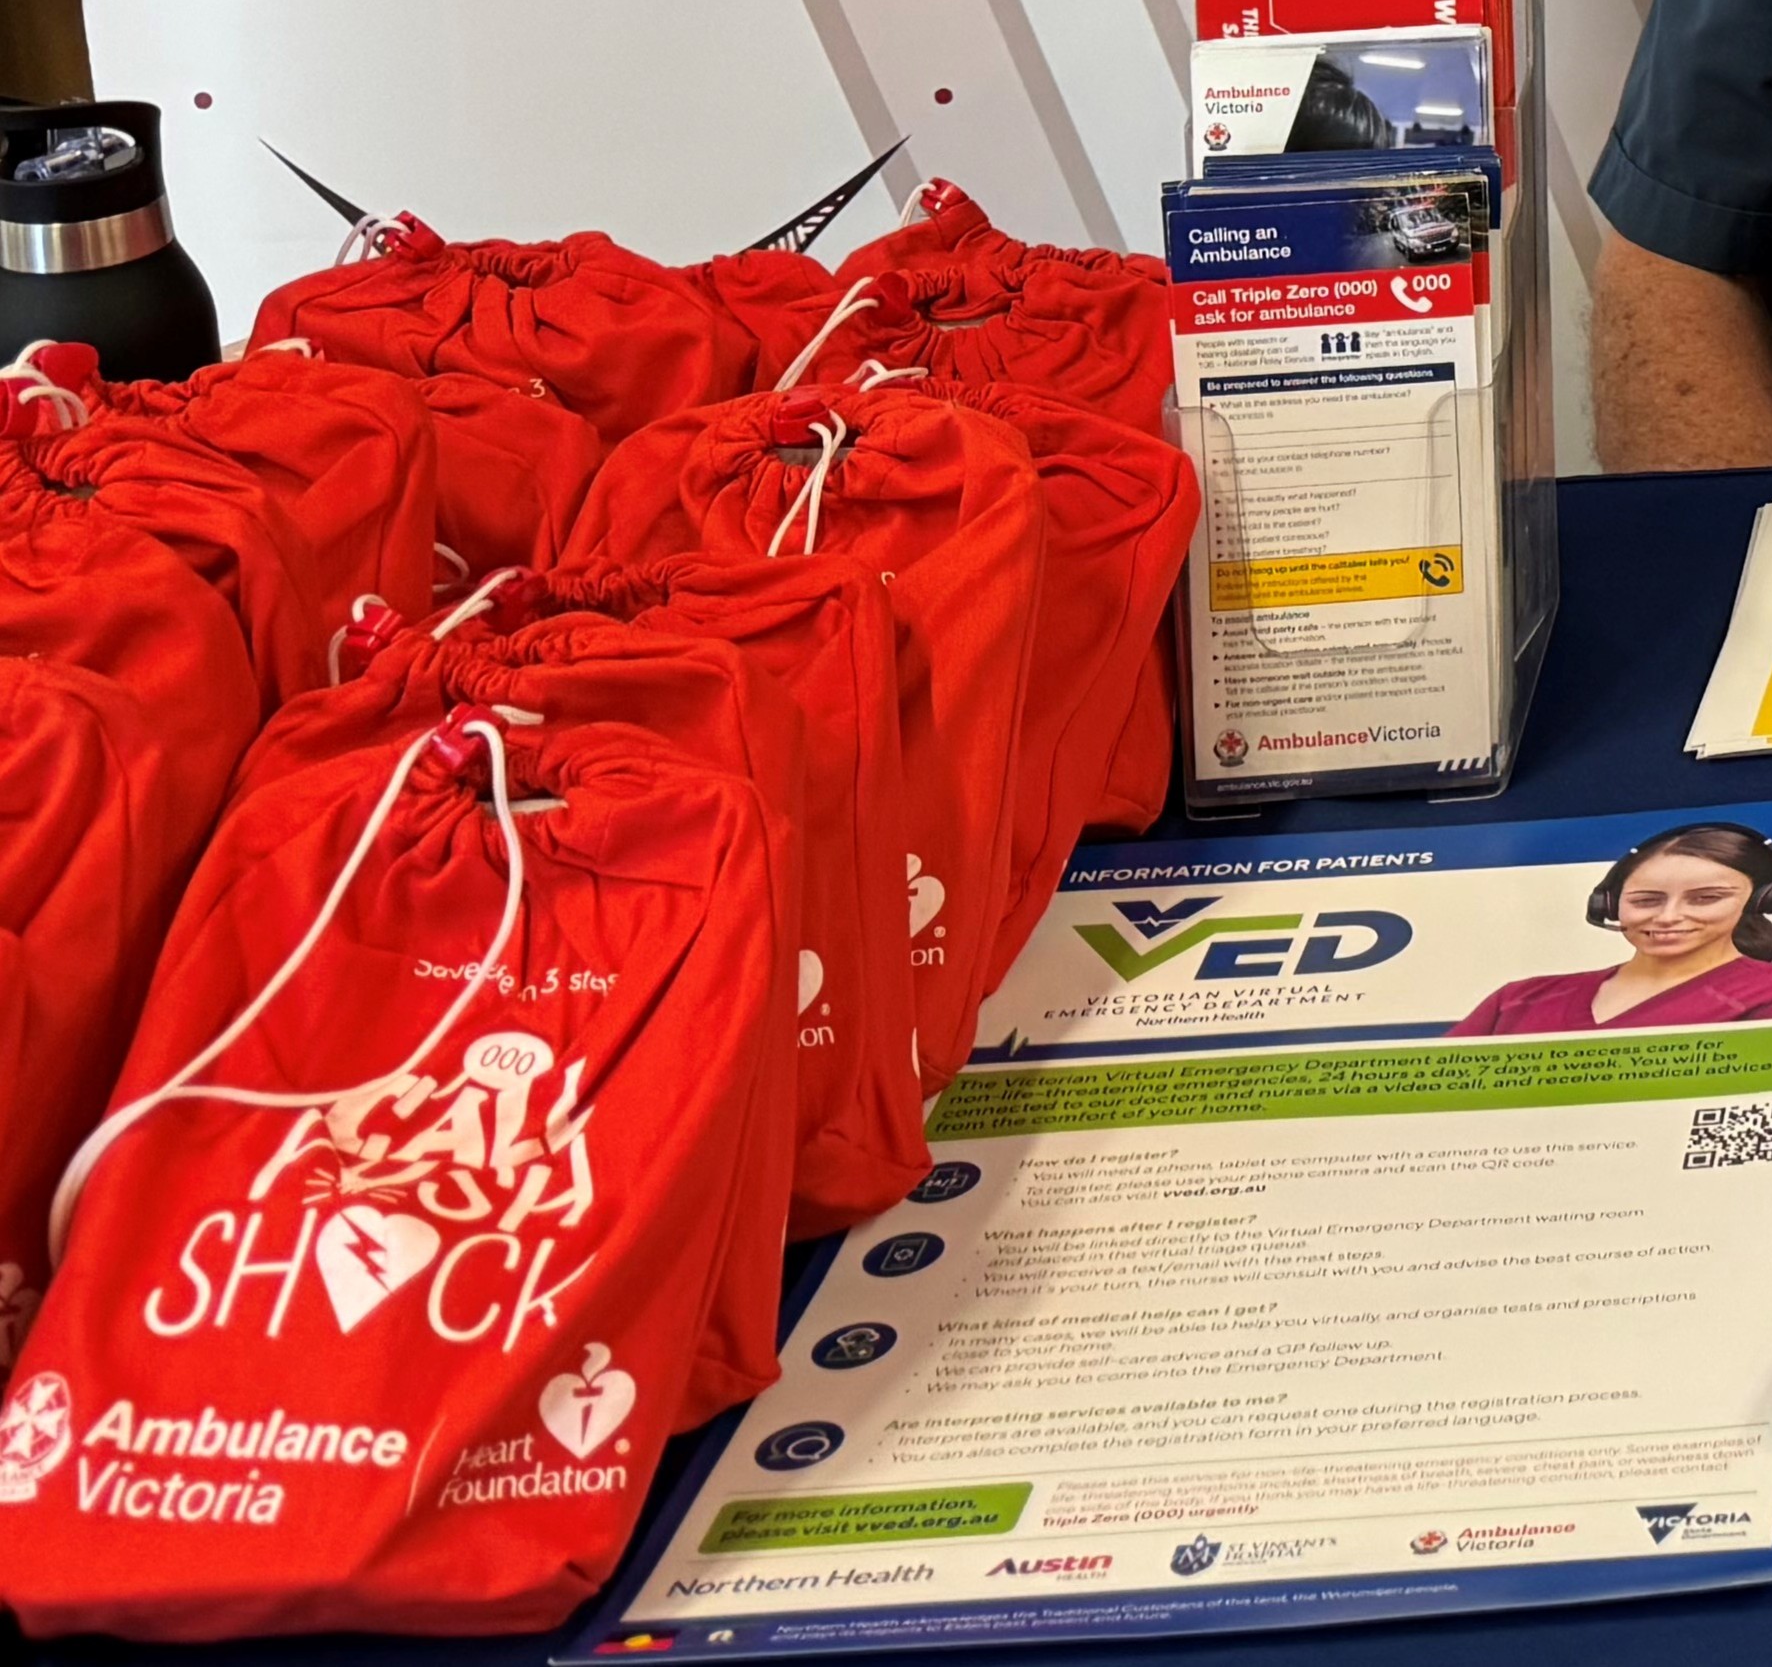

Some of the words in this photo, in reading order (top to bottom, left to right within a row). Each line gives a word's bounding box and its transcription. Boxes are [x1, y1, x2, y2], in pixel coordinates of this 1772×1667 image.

[1205, 85, 1291, 99] Ambulance
[1205, 100, 1264, 115] Victoria
[1189, 227, 1252, 248] Calling
[1257, 227, 1278, 240] an
[1190, 243, 1291, 264] Ambulance
[1193, 287, 1228, 307] Call
[1232, 284, 1282, 308] Triple
[1286, 283, 1330, 302] Zero
[1334, 278, 1379, 301] (000)
[1412, 273, 1451, 293] 000
[1194, 307, 1225, 326] ask
[1229, 307, 1255, 324] for
[1259, 300, 1356, 323] ambulance
[1069, 862, 1252, 884] INFORMATION
[1257, 859, 1312, 874] FOR
[1317, 852, 1433, 871] PATIENTS
[1044, 1002, 1193, 1020] EMERGENCY
[1202, 992, 1367, 1011] DEPARTMENT
[1086, 991, 1221, 1007] VICTORIAN
[1233, 984, 1334, 998] VIRTUAL
[480, 1043, 537, 1076] 000
[83, 1399, 408, 1469] Ambulance
[455, 1432, 533, 1476] Heart
[76, 1460, 286, 1524] Victoria
[438, 1464, 627, 1509] Foundation
[732, 1509, 768, 1524] For
[774, 1509, 834, 1520] more
[1643, 1511, 1752, 1531] VICTORIA
[804, 1522, 849, 1535] visit
[1458, 1521, 1576, 1540] Ambulance
[1456, 1537, 1535, 1553] Victoria
[984, 1554, 1113, 1573] Austin
[666, 1569, 820, 1598] Northern
[825, 1563, 934, 1588] Health
